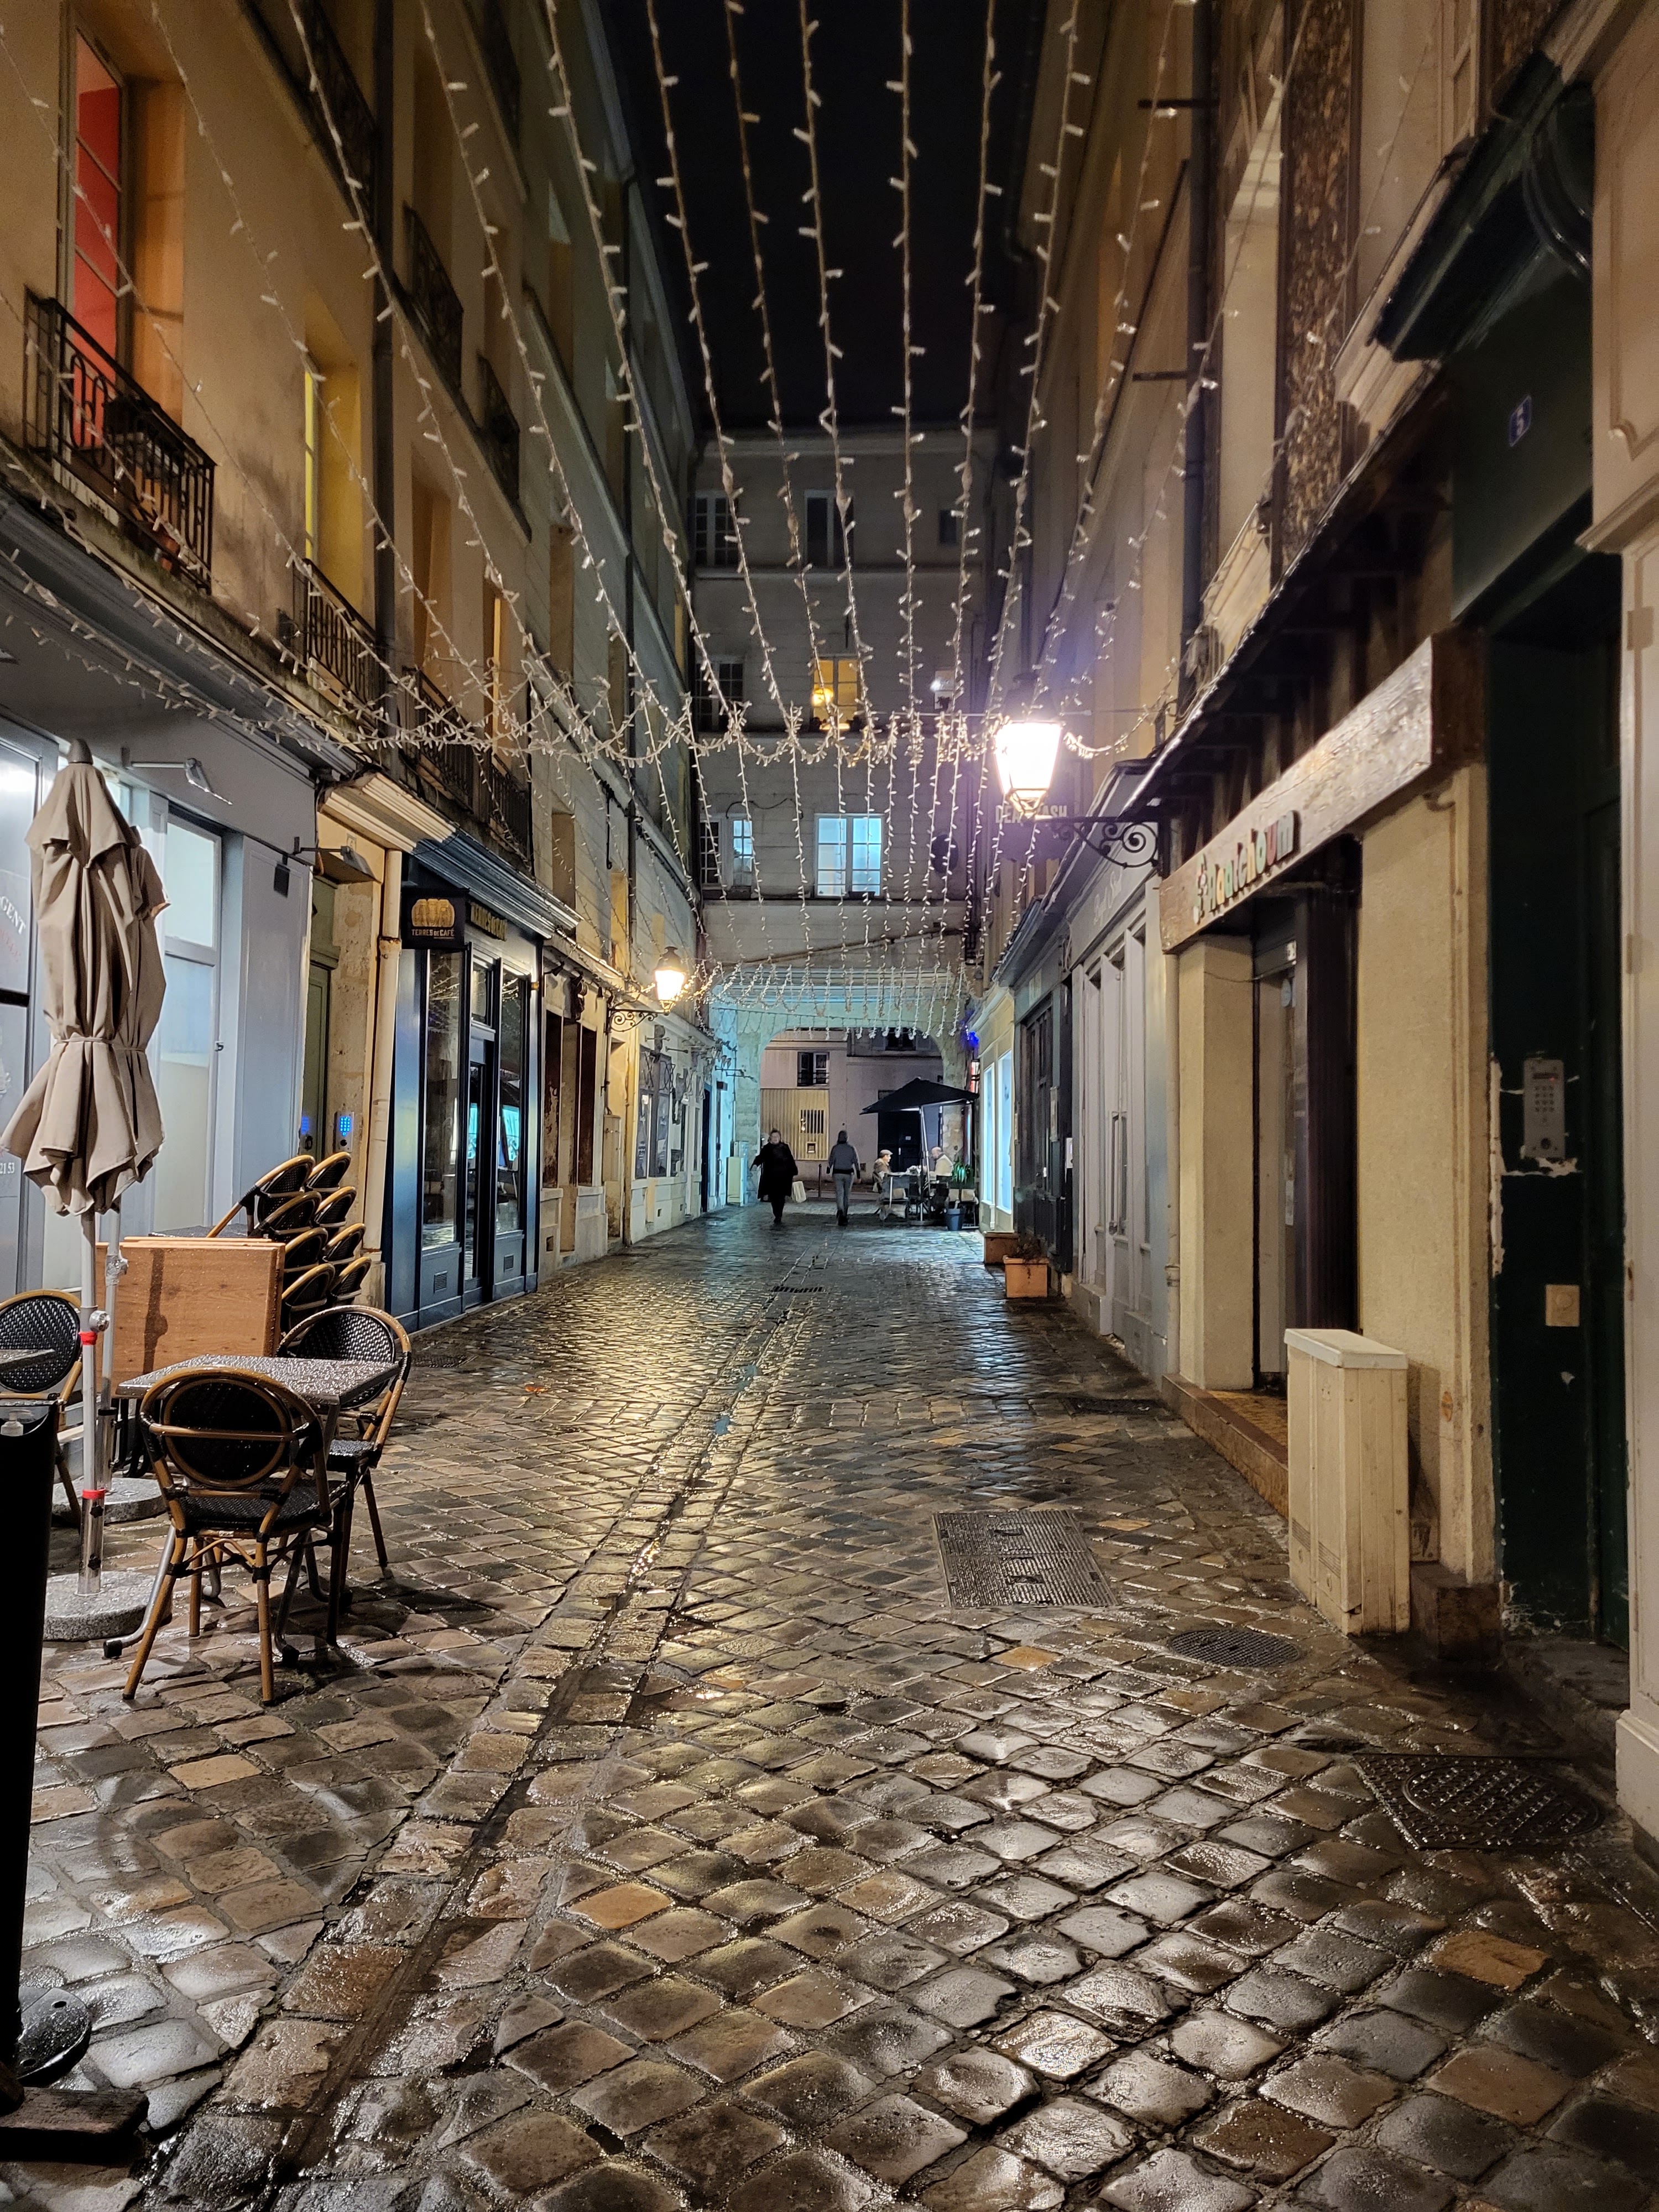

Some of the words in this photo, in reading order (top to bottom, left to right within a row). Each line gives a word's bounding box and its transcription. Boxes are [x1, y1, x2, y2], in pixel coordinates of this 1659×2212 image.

[1516, 406, 1524, 436] 5
[440, 928, 455, 937] CAFÉ
[8, 1162, 15, 1174] 53
